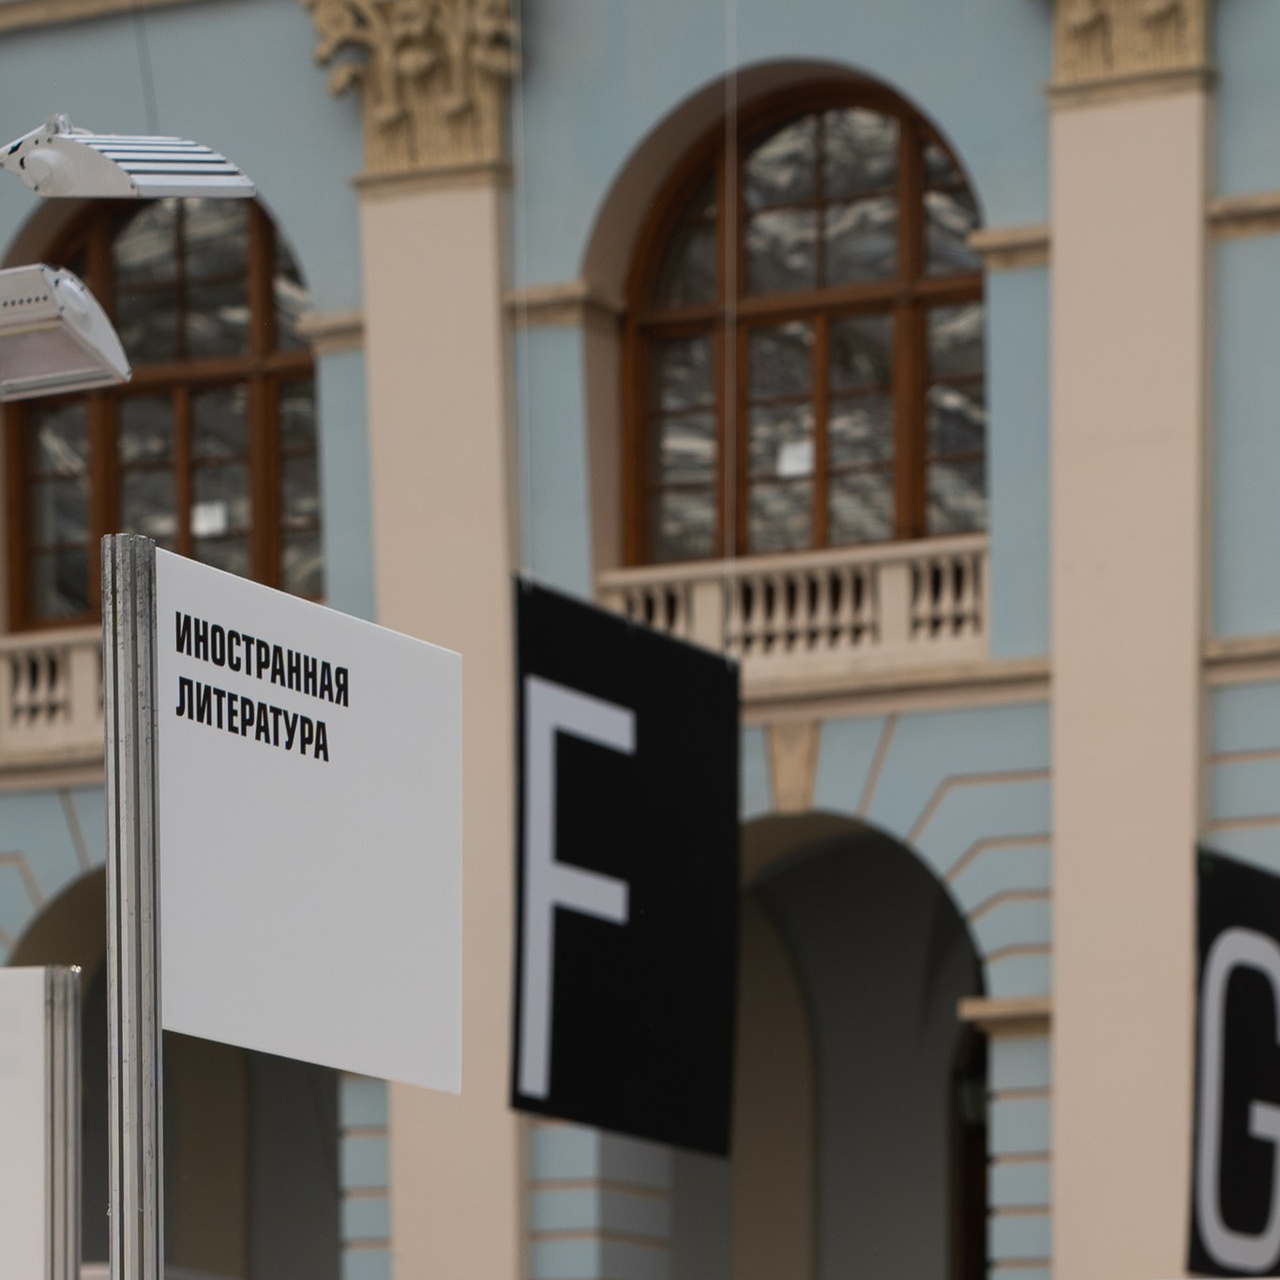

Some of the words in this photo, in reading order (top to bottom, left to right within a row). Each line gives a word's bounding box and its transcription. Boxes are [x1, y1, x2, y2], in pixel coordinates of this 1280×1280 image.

[175, 610, 349, 708] ИНОСТРАННАЯ
[175, 675, 329, 763] ЛИТЕРАТУРА
[519, 673, 636, 1100] F
